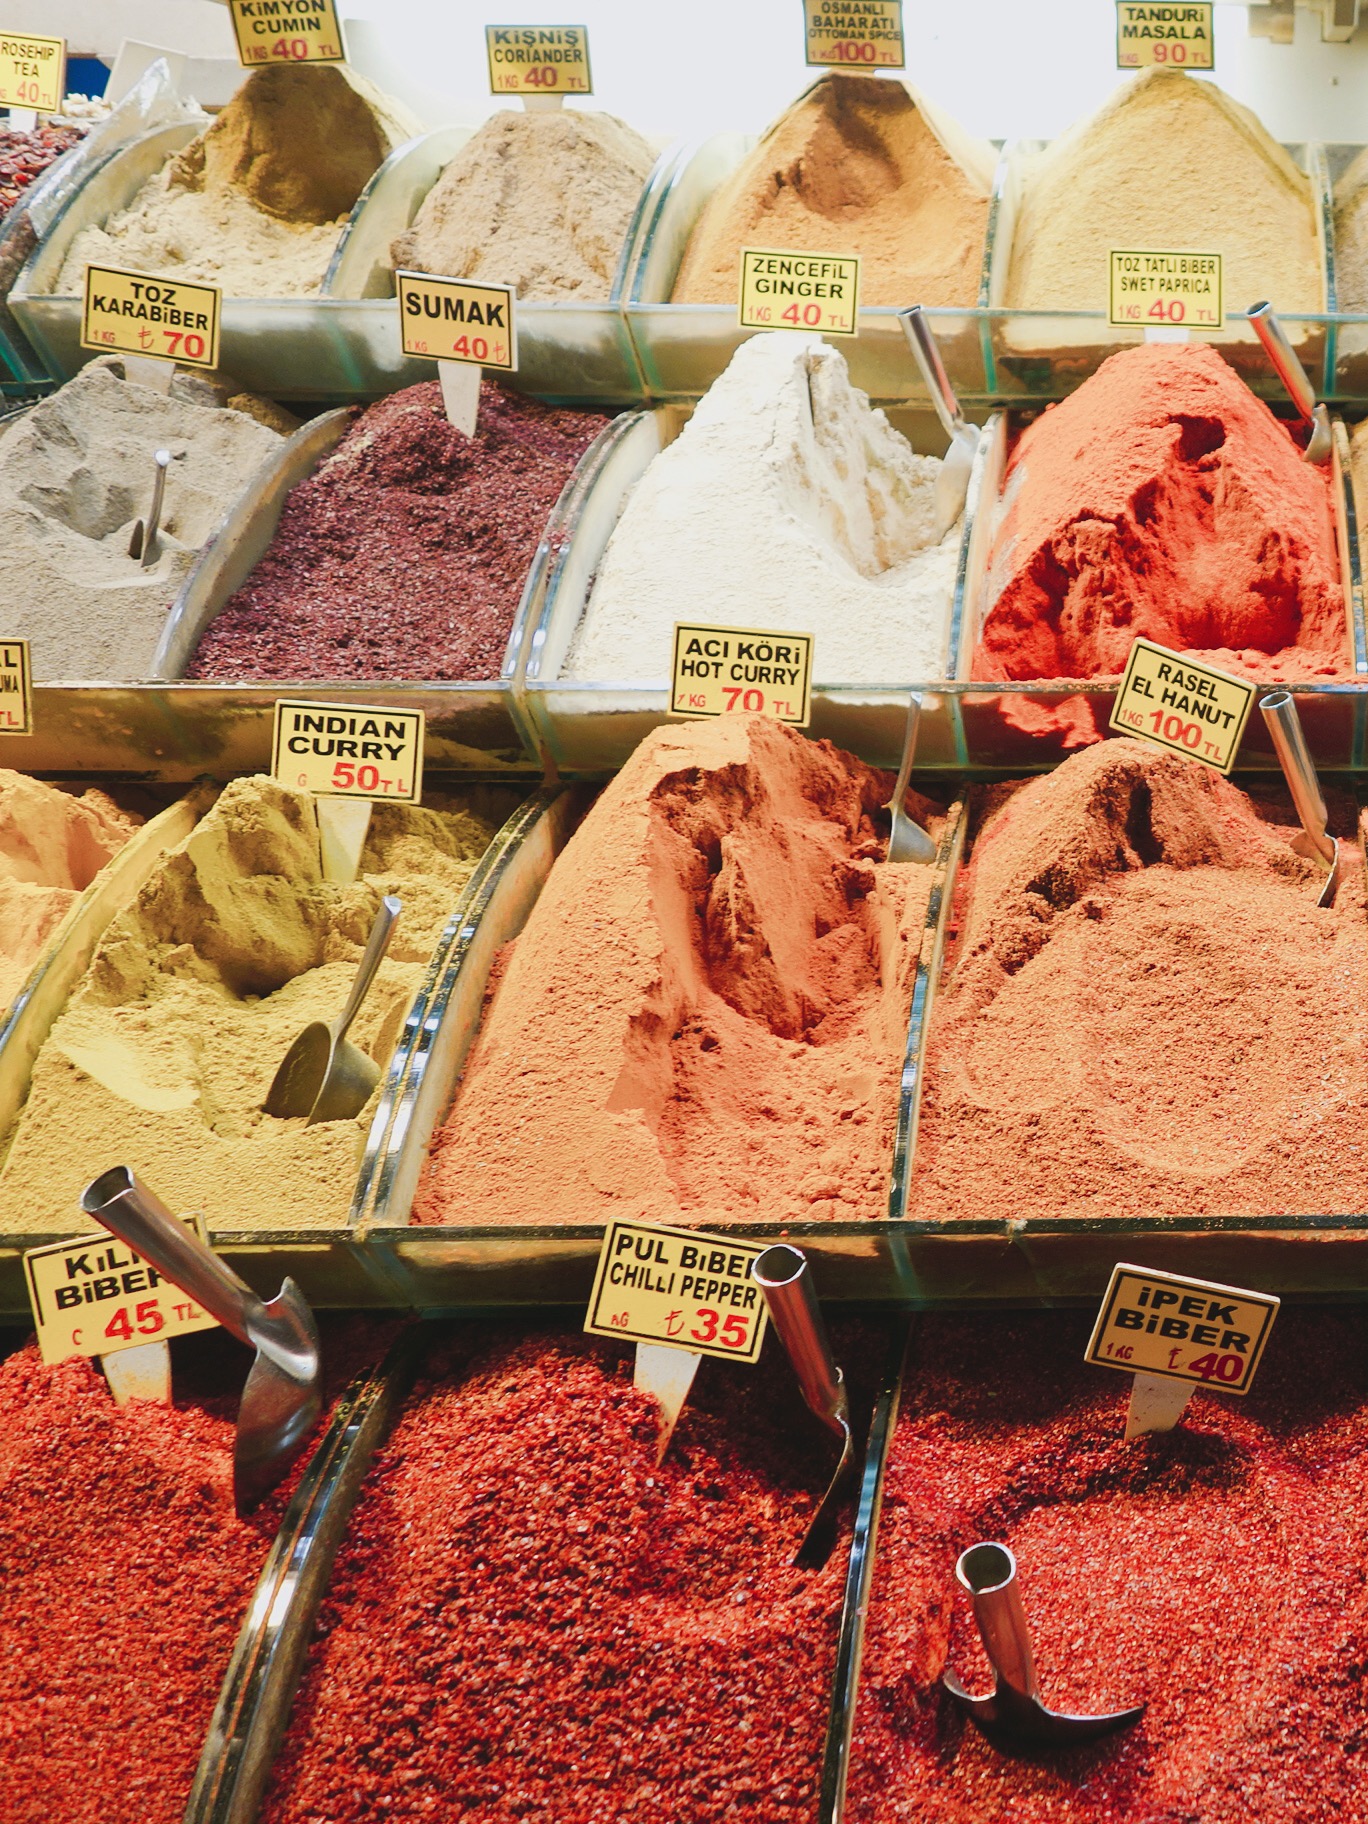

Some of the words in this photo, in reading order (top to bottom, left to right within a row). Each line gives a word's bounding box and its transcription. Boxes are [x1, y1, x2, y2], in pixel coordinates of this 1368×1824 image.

[821, 2, 884, 15] OSMANLI
[253, 17, 321, 34] CUMIN
[813, 15, 894, 29] BAHARATI
[1123, 25, 1206, 40] MASALA
[809, 28, 865, 39] OTTOMAN
[868, 30, 901, 40] SPICE
[1, 42, 54, 60] ROSEHIP
[272, 38, 308, 60] 40
[318, 45, 337, 55] TL
[494, 48, 583, 63] CORIANDER
[832, 41, 876, 62] 100
[880, 52, 897, 62] TL
[1153, 43, 1186, 63] 90
[1192, 53, 1209, 63] TL
[14, 62, 39, 78] TEA
[525, 66, 557, 87] 40
[570, 78, 586, 88] TL
[17, 82, 39, 103] 40
[42, 92, 53, 105] TL
[1116, 258, 1140, 271] TOZ
[1145, 259, 1177, 272] TATLI
[131, 282, 176, 305] TOZ
[756, 279, 844, 298] GINGER
[1121, 277, 1155, 292] SWET
[1158, 279, 1211, 294] PAPRICA
[405, 292, 505, 327] SUMAK
[781, 303, 821, 325] 40
[829, 314, 848, 327] TL
[1148, 299, 1185, 322] 40
[1197, 310, 1216, 321] TL
[164, 331, 205, 358] 70
[453, 336, 488, 359] 40
[686, 639, 729, 658] ACI
[681, 661, 723, 679] HOT
[731, 663, 801, 685] CURRY
[1157, 663, 1219, 702] RASEL
[688, 694, 706, 707] KG
[721, 687, 763, 713] 70
[774, 700, 795, 716] TL
[1132, 676, 1155, 700] EL
[1154, 684, 1236, 731] HANUT
[293, 714, 405, 739] INDIAN
[1149, 710, 1203, 750] 100
[1203, 741, 1222, 762] TL
[287, 736, 406, 761] CURRY
[331, 762, 380, 791] 50
[615, 1234, 669, 1264] PUL
[610, 1262, 675, 1294] CHILLI
[680, 1275, 757, 1309] PEPPER
[104, 1299, 167, 1340] 45
[172, 1303, 200, 1321] TL
[690, 1307, 749, 1347] 35
[1189, 1352, 1244, 1383] 40
